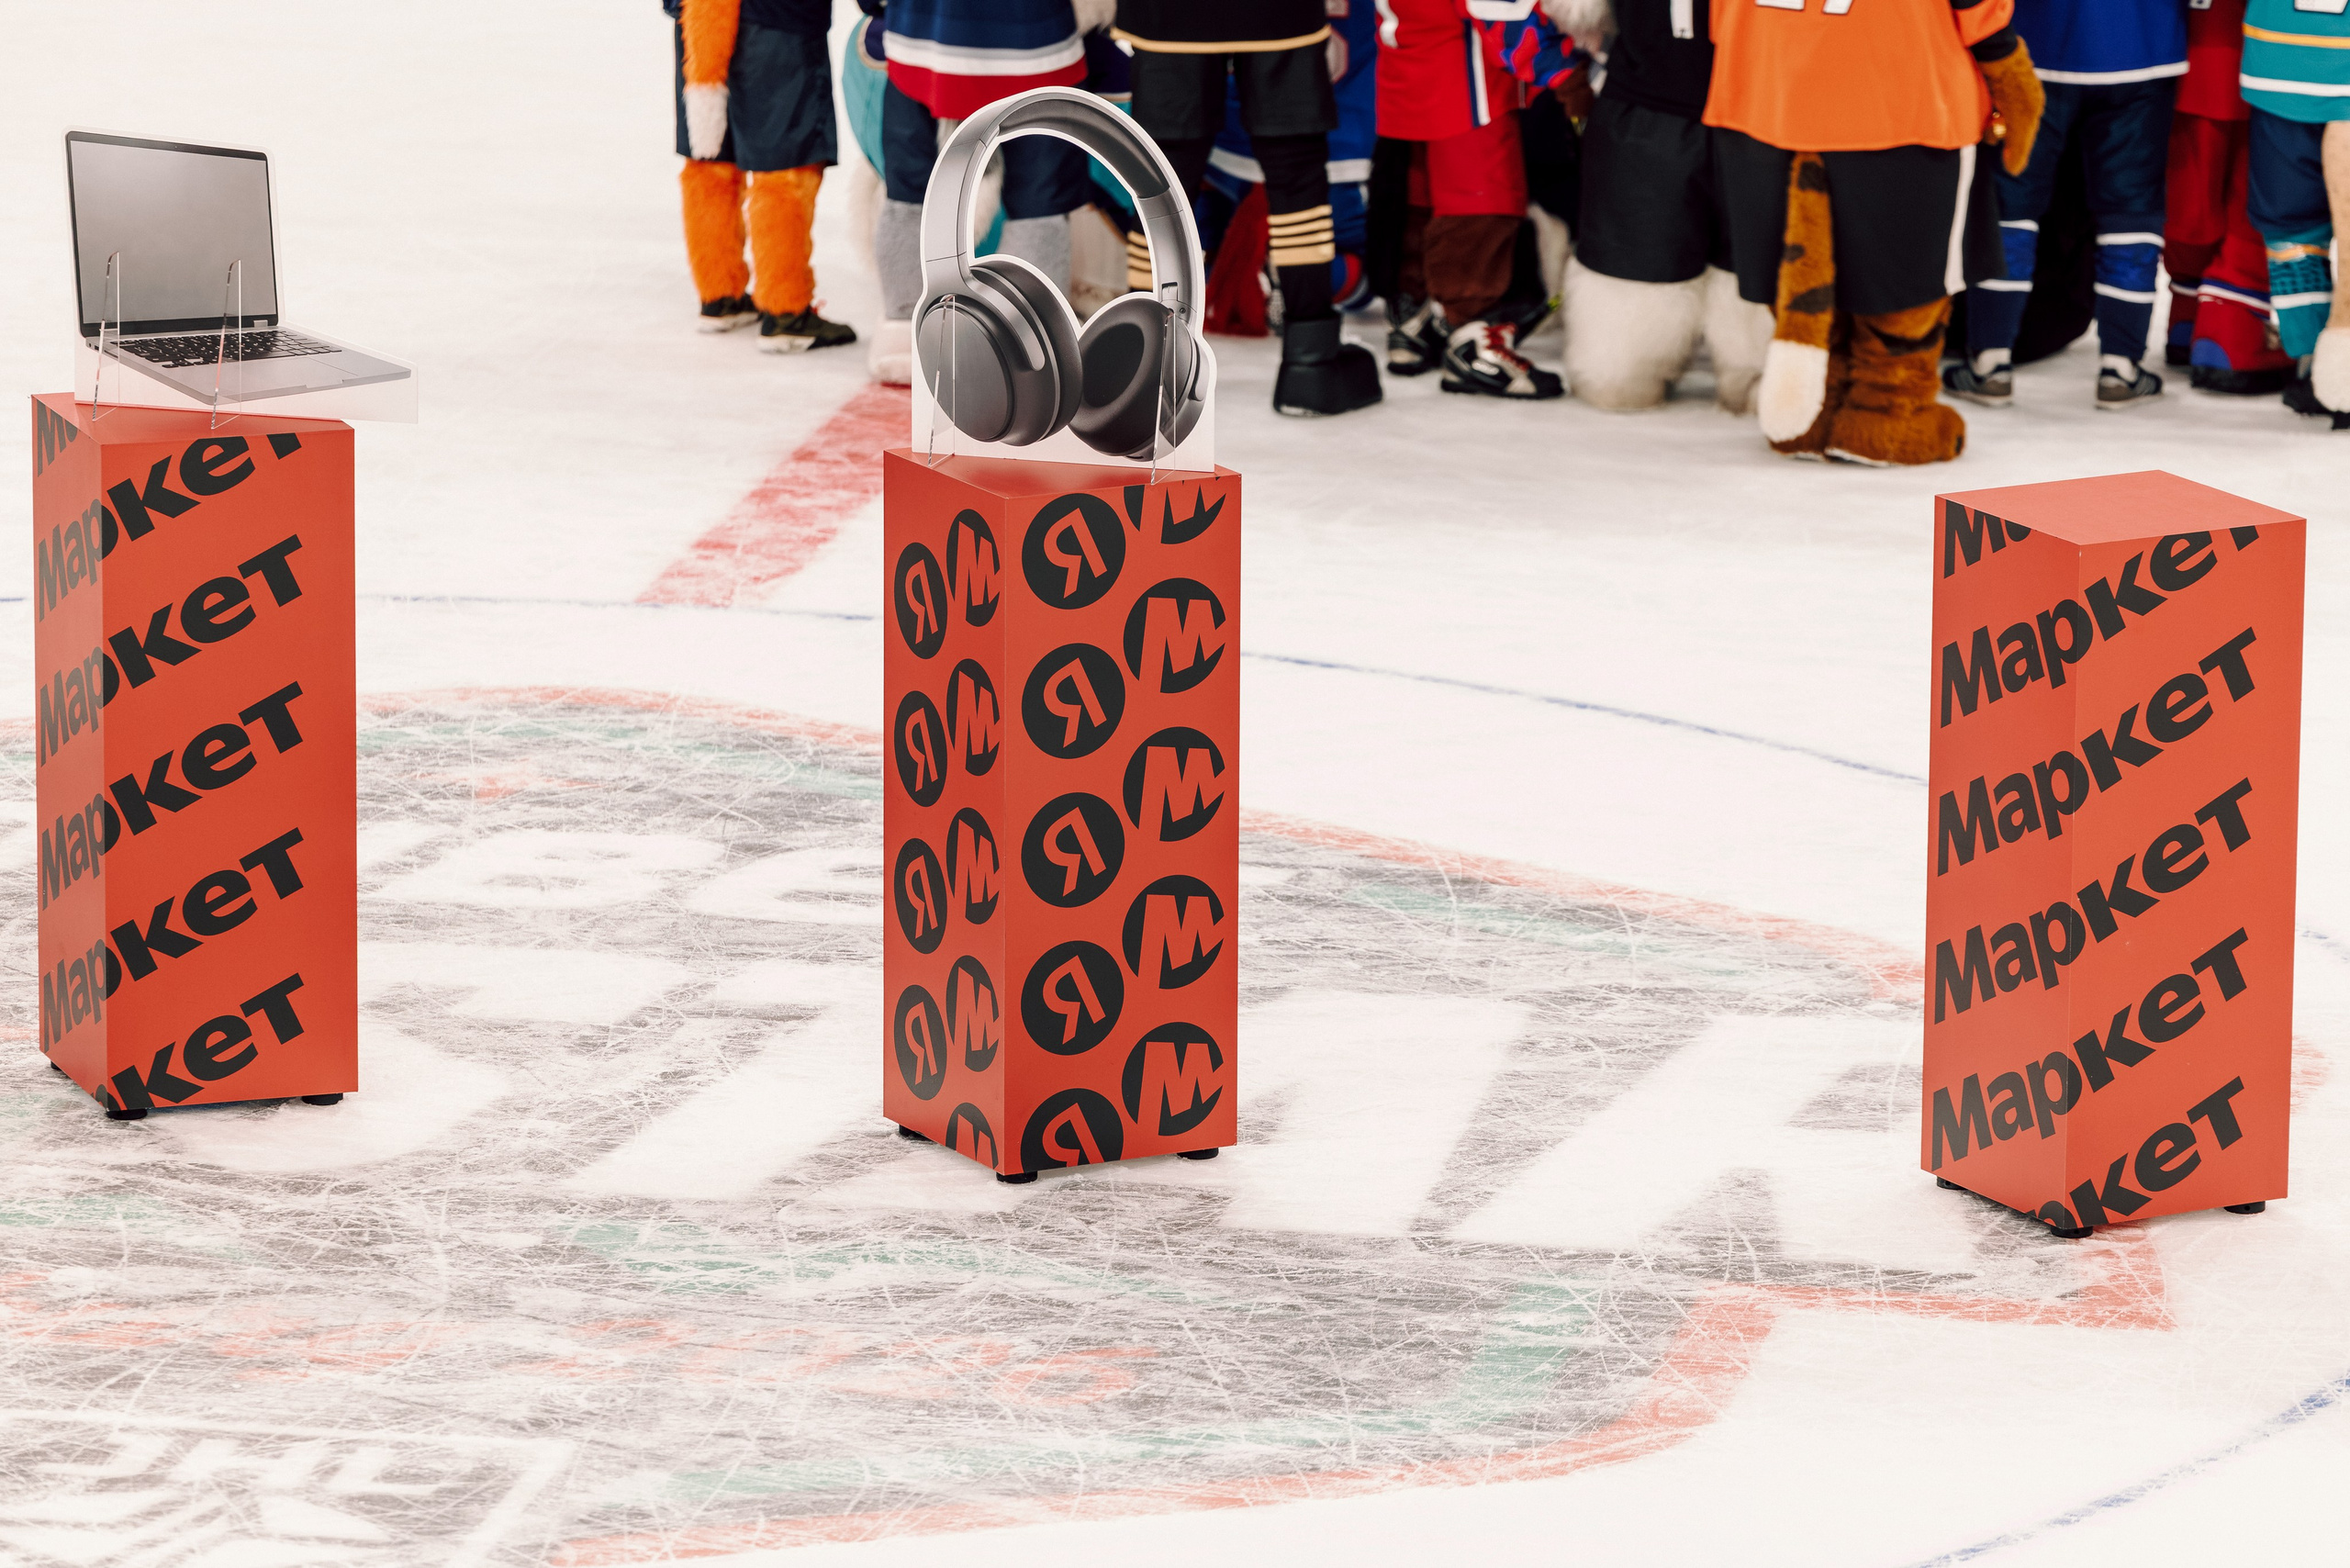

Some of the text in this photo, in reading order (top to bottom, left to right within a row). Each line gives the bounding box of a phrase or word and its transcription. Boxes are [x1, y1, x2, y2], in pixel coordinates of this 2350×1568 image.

[1041, 505, 1110, 601] Я
[902, 556, 941, 647] Я
[40, 534, 303, 766] Маркет
[902, 705, 941, 796] Я
[1040, 655, 1109, 751] Я
[41, 681, 303, 910] Маркет
[1938, 627, 2256, 877] Маркет
[902, 852, 941, 943] Я
[1040, 803, 1109, 900] Я
[43, 827, 304, 1052] Маркет
[1934, 778, 2252, 1024] Маркет
[902, 999, 941, 1090] Я
[1039, 952, 1108, 1048] Я
[1931, 927, 2248, 1171] Маркет
